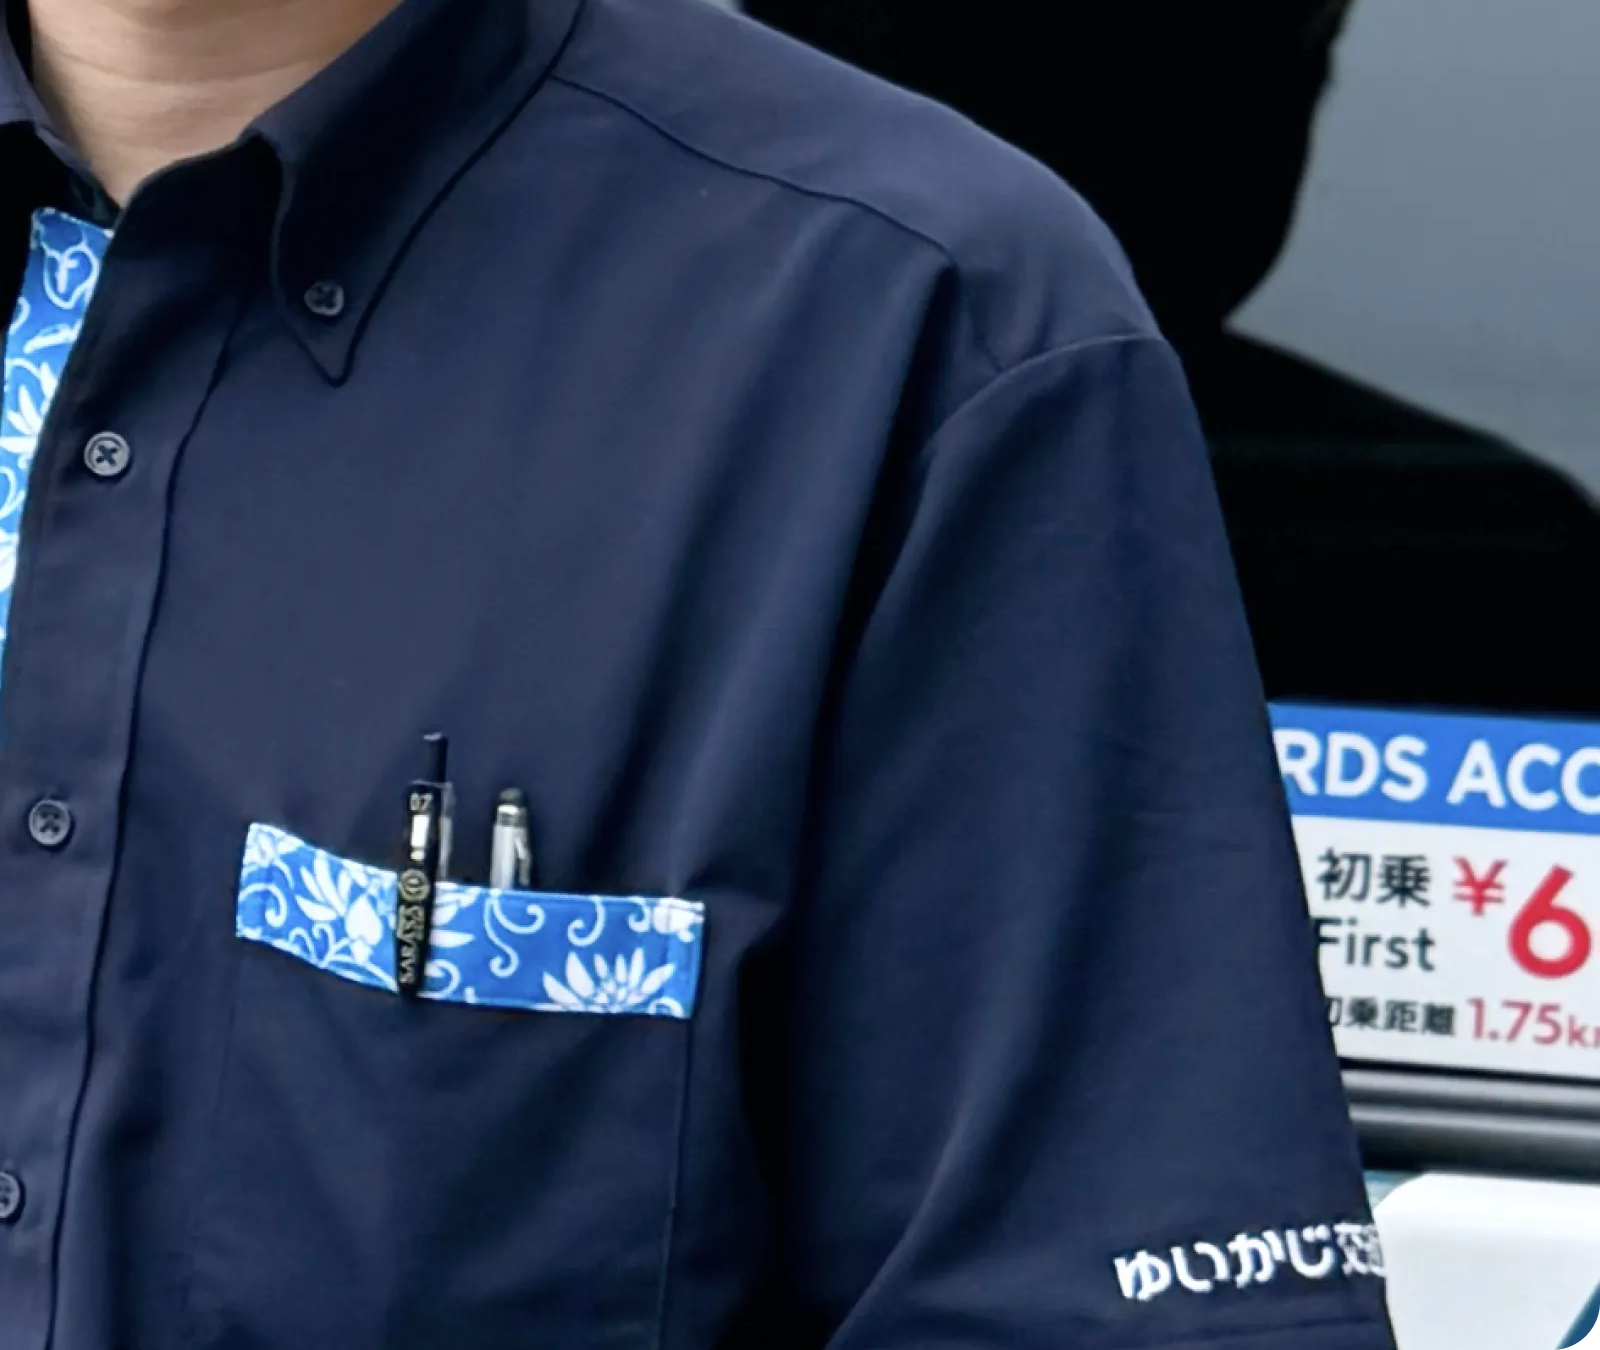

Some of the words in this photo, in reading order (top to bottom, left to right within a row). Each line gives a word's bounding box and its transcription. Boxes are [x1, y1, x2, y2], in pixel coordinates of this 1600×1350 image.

[1273, 729, 1428, 802] RDS
[1317, 848, 1431, 907] 初乗
[1313, 917, 1435, 972] First
[1467, 997, 1600, 1048] 1.75k
